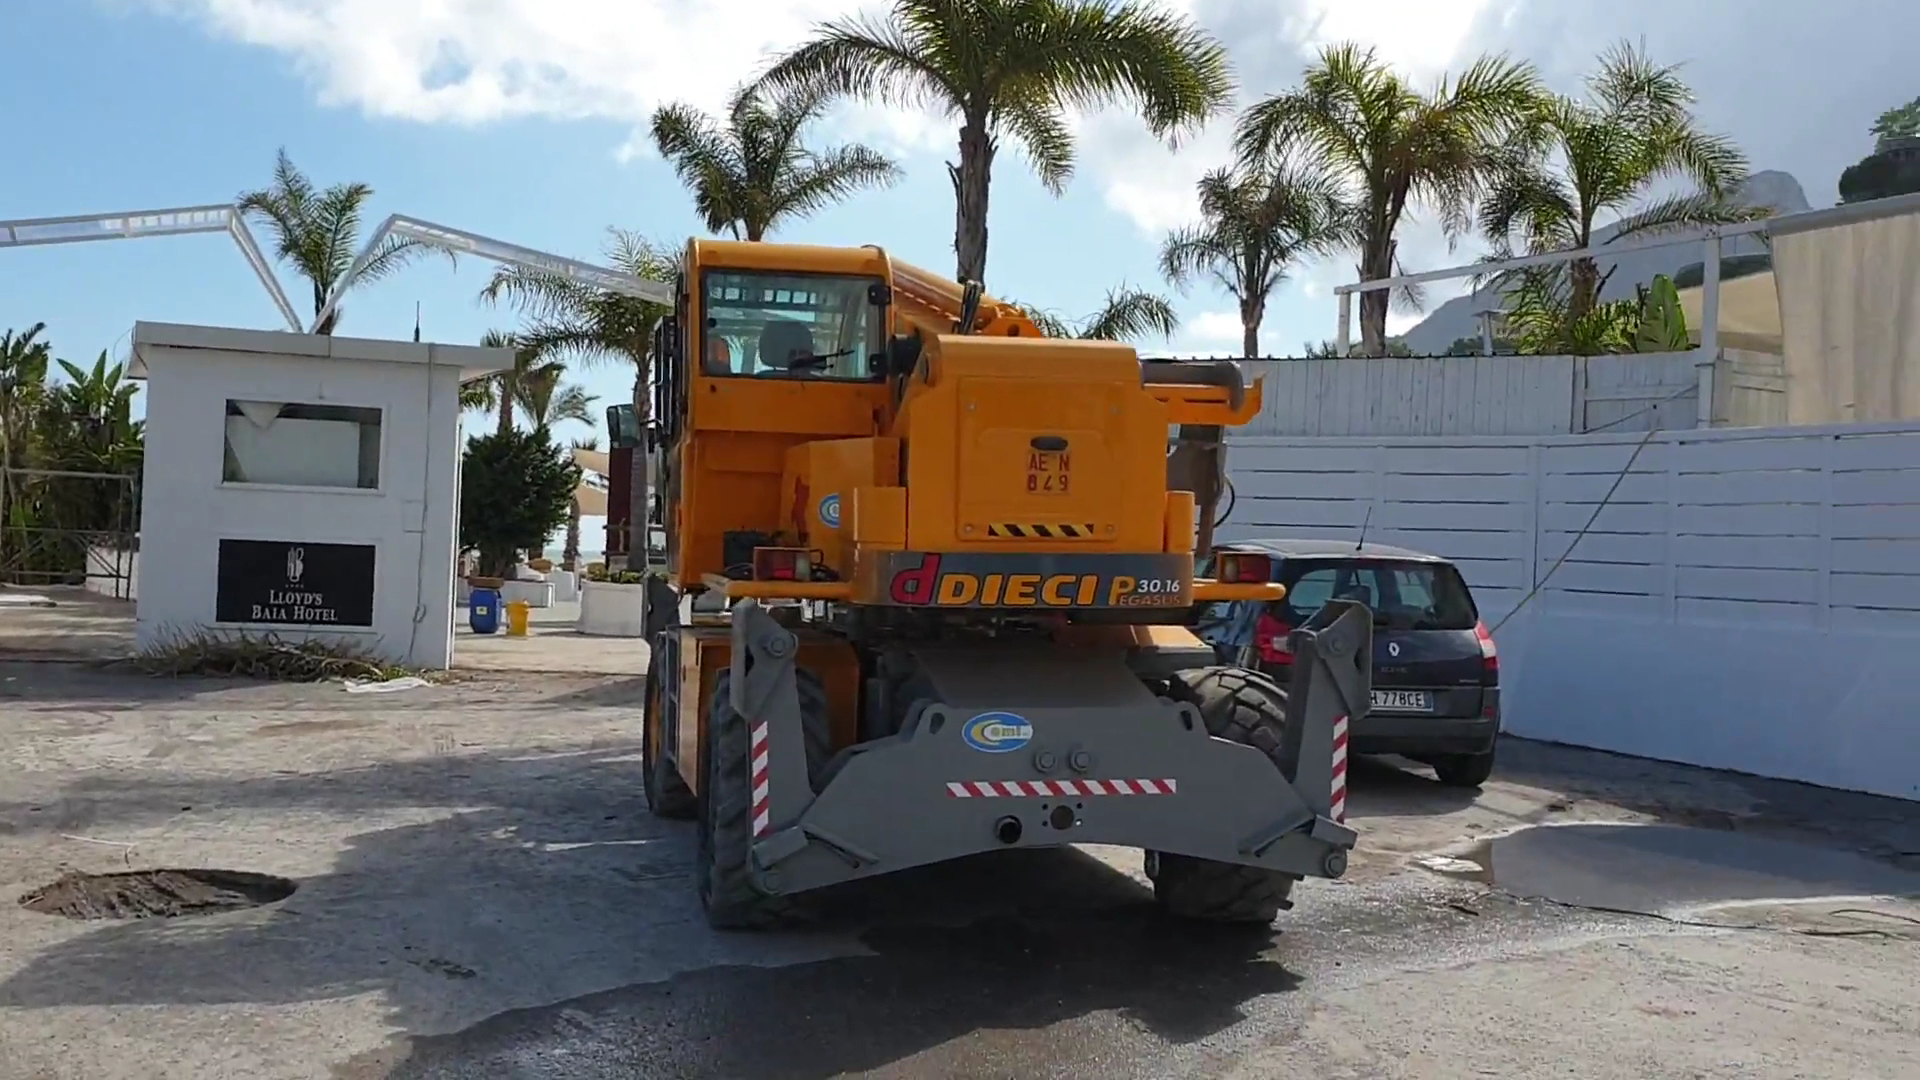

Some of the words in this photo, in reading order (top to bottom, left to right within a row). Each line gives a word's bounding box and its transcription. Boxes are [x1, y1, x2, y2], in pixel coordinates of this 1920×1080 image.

[1028, 453, 1049, 471] AE
[1059, 453, 1070, 471] N
[1137, 579, 1180, 593] 30.16
